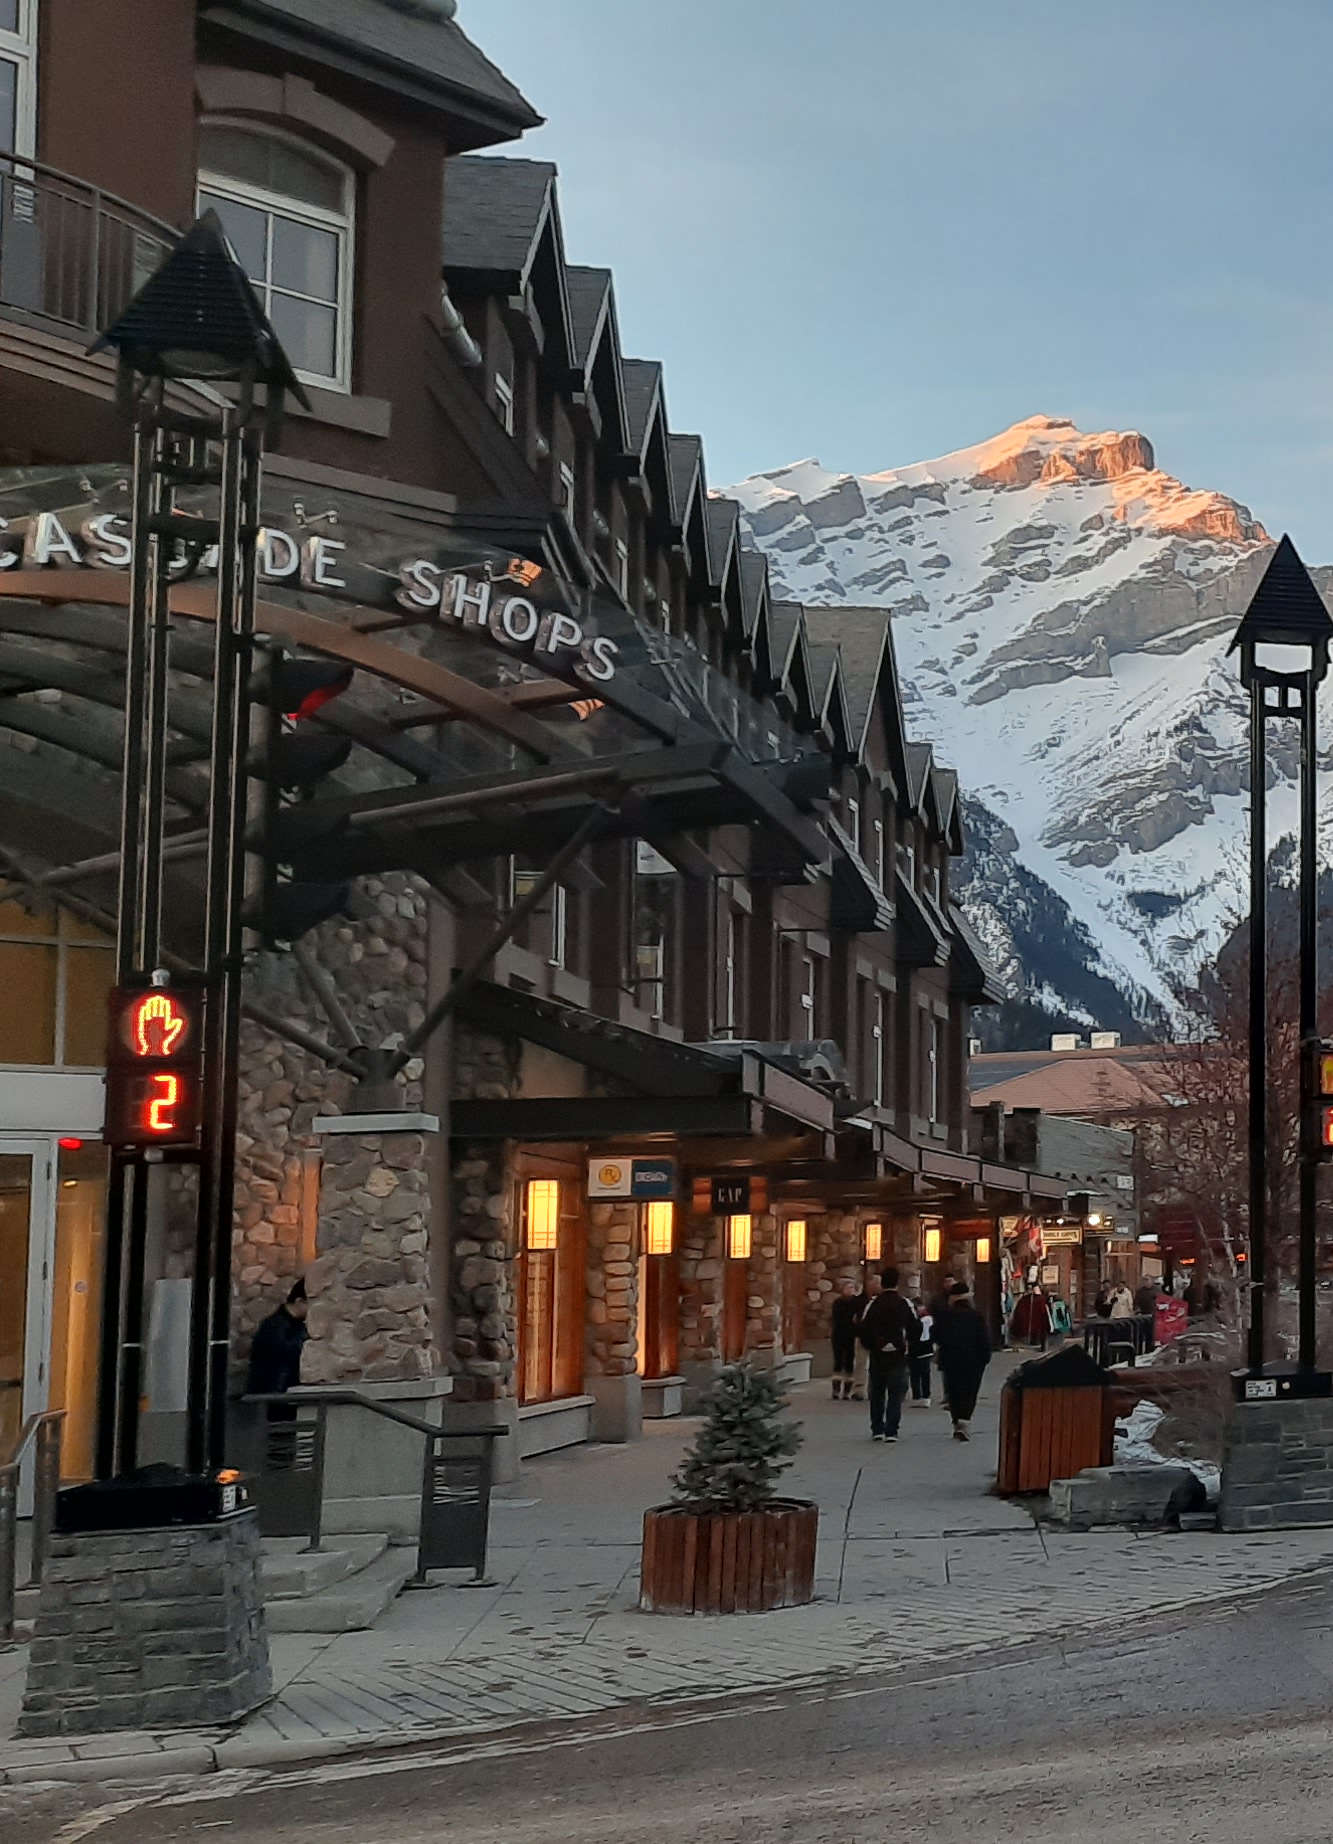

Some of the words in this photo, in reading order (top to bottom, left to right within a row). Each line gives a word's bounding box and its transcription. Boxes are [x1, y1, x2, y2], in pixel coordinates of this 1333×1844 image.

[0, 512, 347, 588] ASDE
[403, 559, 619, 680] SHOPS
[150, 1075, 177, 1130] 2
[718, 1188, 742, 1202] GAP
